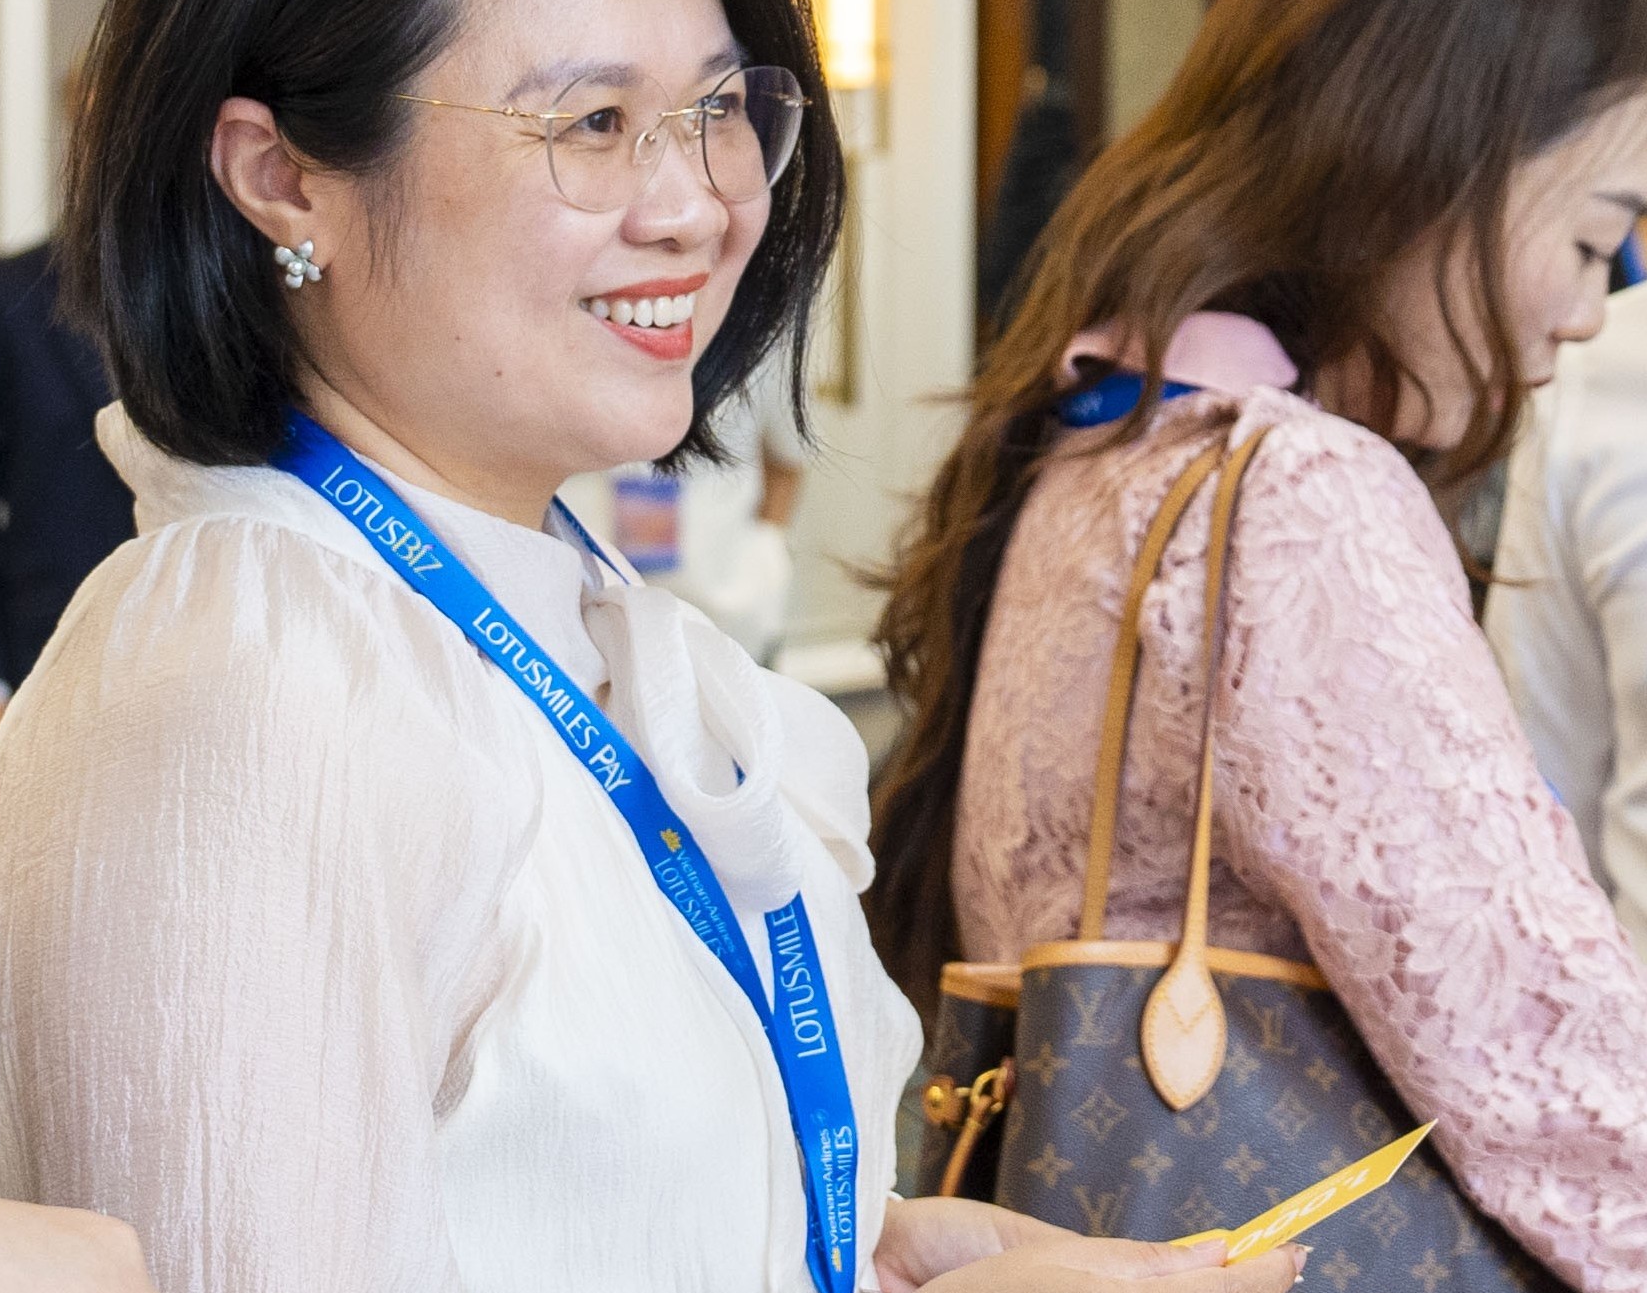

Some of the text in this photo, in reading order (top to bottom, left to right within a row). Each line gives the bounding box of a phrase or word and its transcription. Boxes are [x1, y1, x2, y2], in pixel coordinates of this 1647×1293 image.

[471, 607, 632, 794] LOTUSMILES PAY
[654, 857, 727, 958] LOTUSMILES
[773, 904, 826, 1058] LOTUSMILE
[835, 1124, 853, 1244] LOTUSMILES
